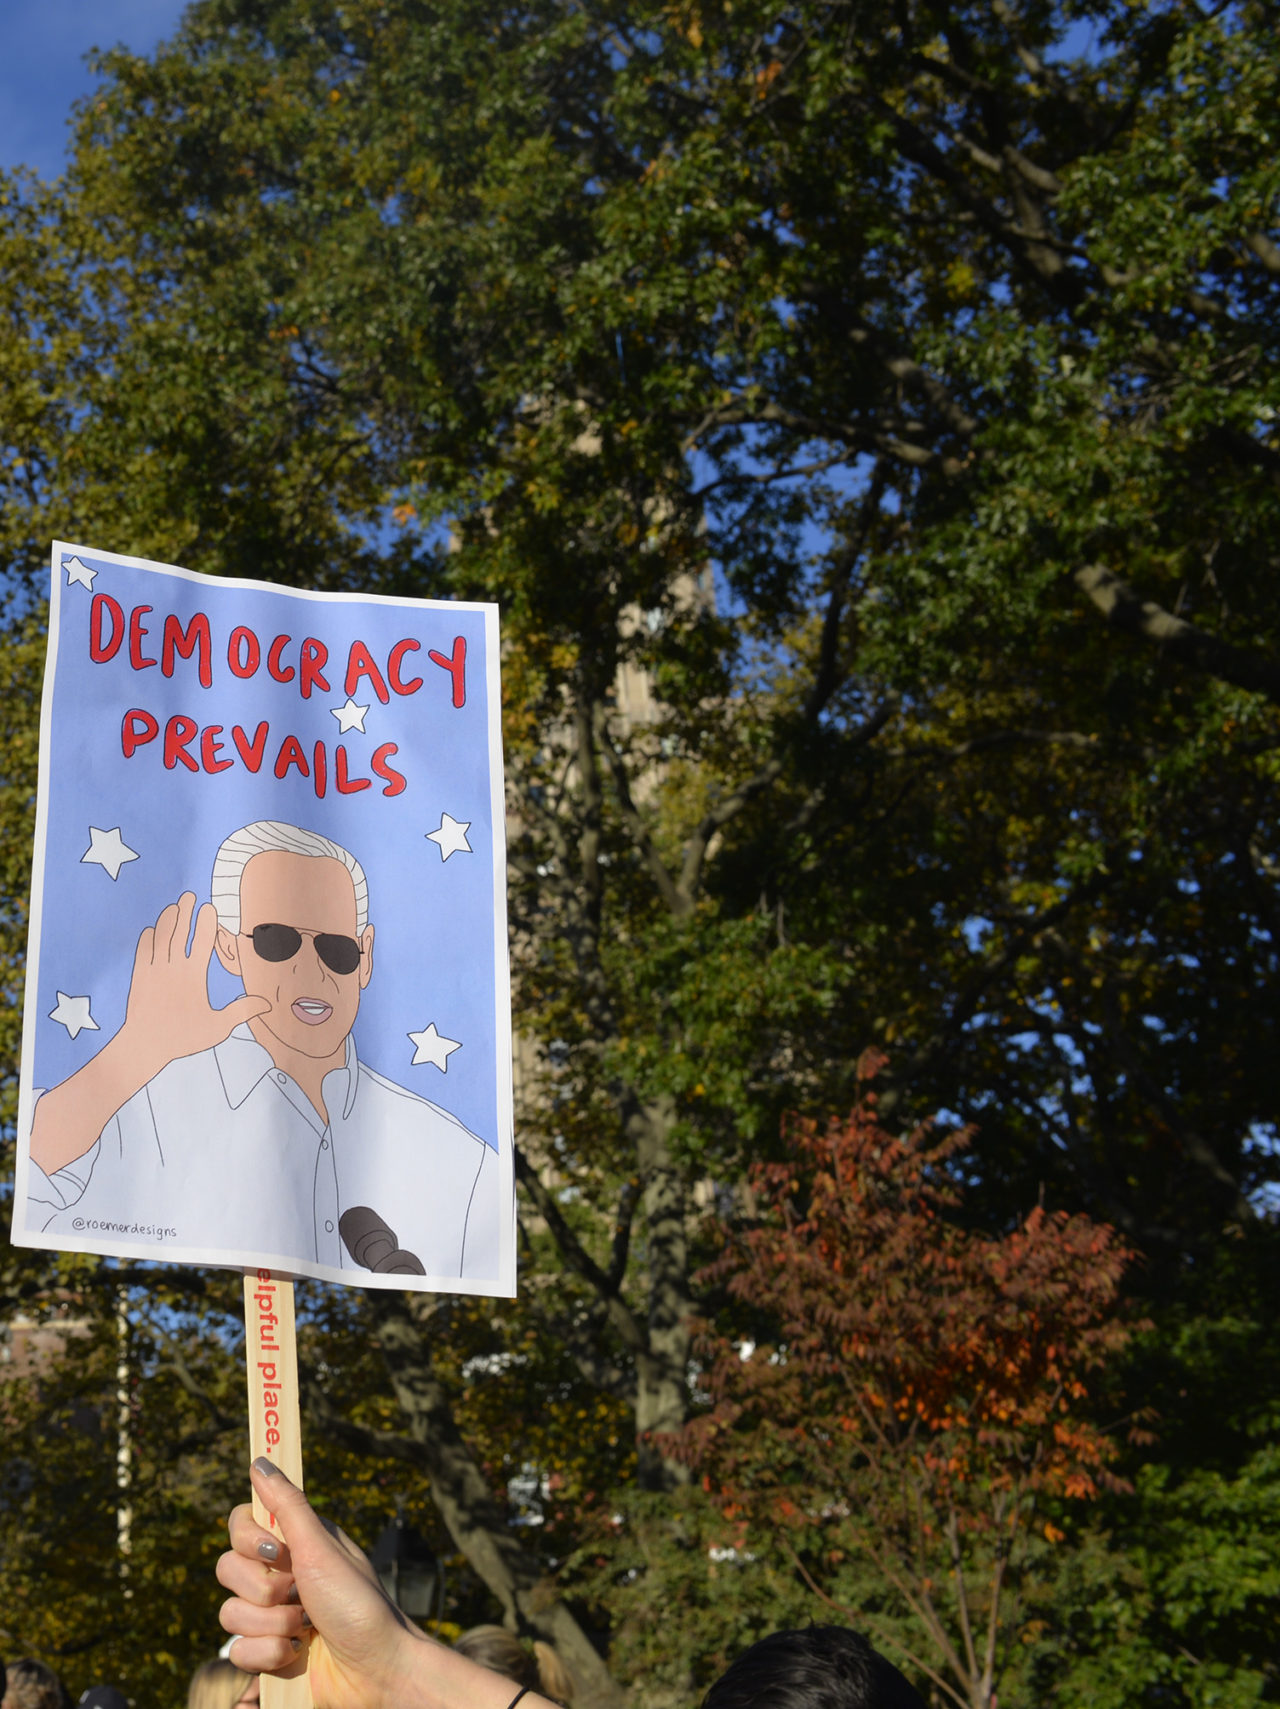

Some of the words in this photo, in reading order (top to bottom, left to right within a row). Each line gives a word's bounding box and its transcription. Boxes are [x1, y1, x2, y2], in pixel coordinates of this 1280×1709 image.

[89, 593, 467, 709] DEMOCRACY
[121, 708, 407, 799] PREVAILS
[72, 1217, 177, 1240] @roemerdesigns
[254, 1268, 280, 1351] elpful
[257, 1362, 282, 1453] place.
